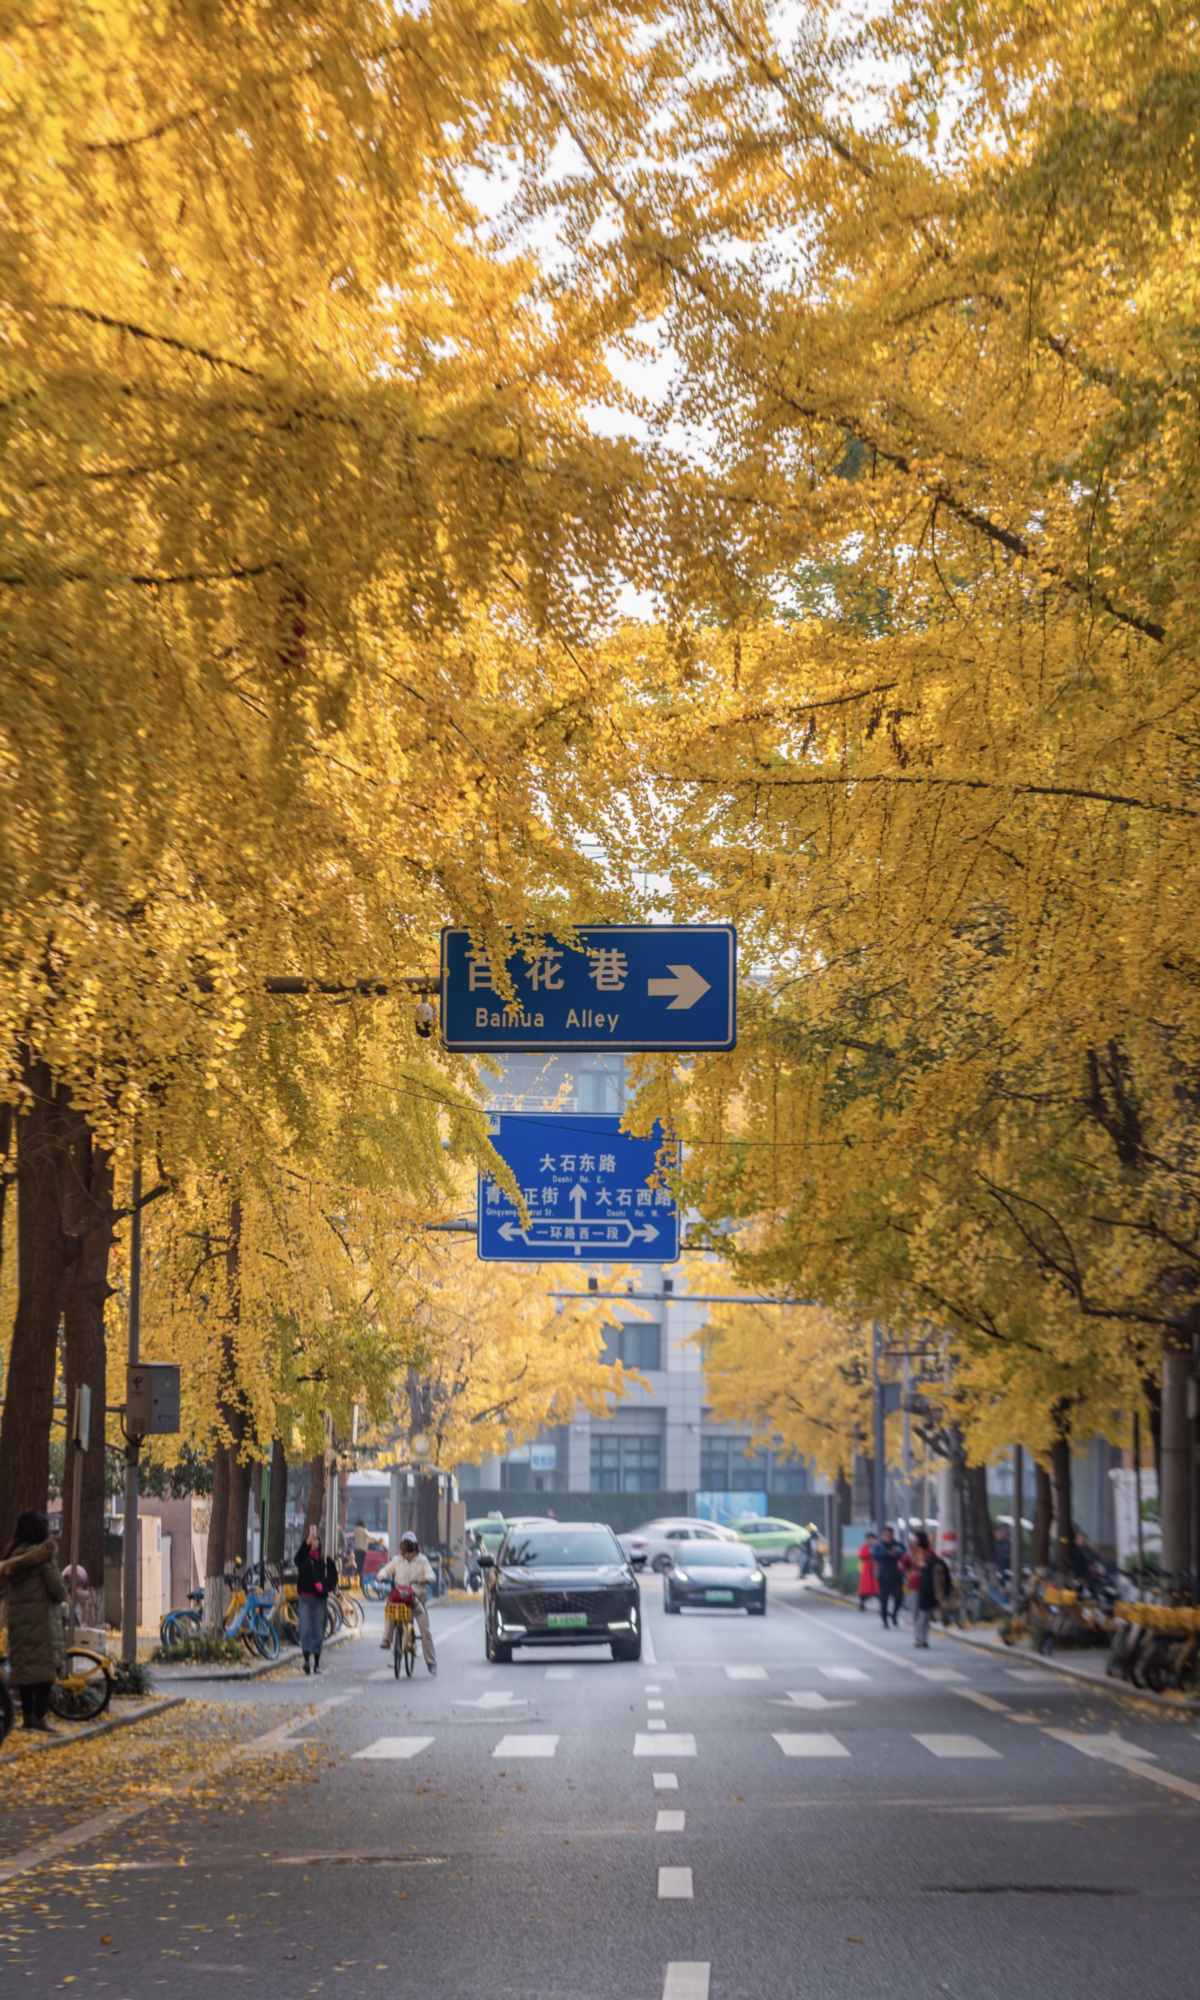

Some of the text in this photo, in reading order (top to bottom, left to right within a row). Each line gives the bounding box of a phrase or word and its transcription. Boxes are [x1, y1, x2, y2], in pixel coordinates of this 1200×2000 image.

[566, 1008, 619, 1032] Alley
[539, 1153, 617, 1173] 大石东路
[486, 1186, 559, 1205] 青正街
